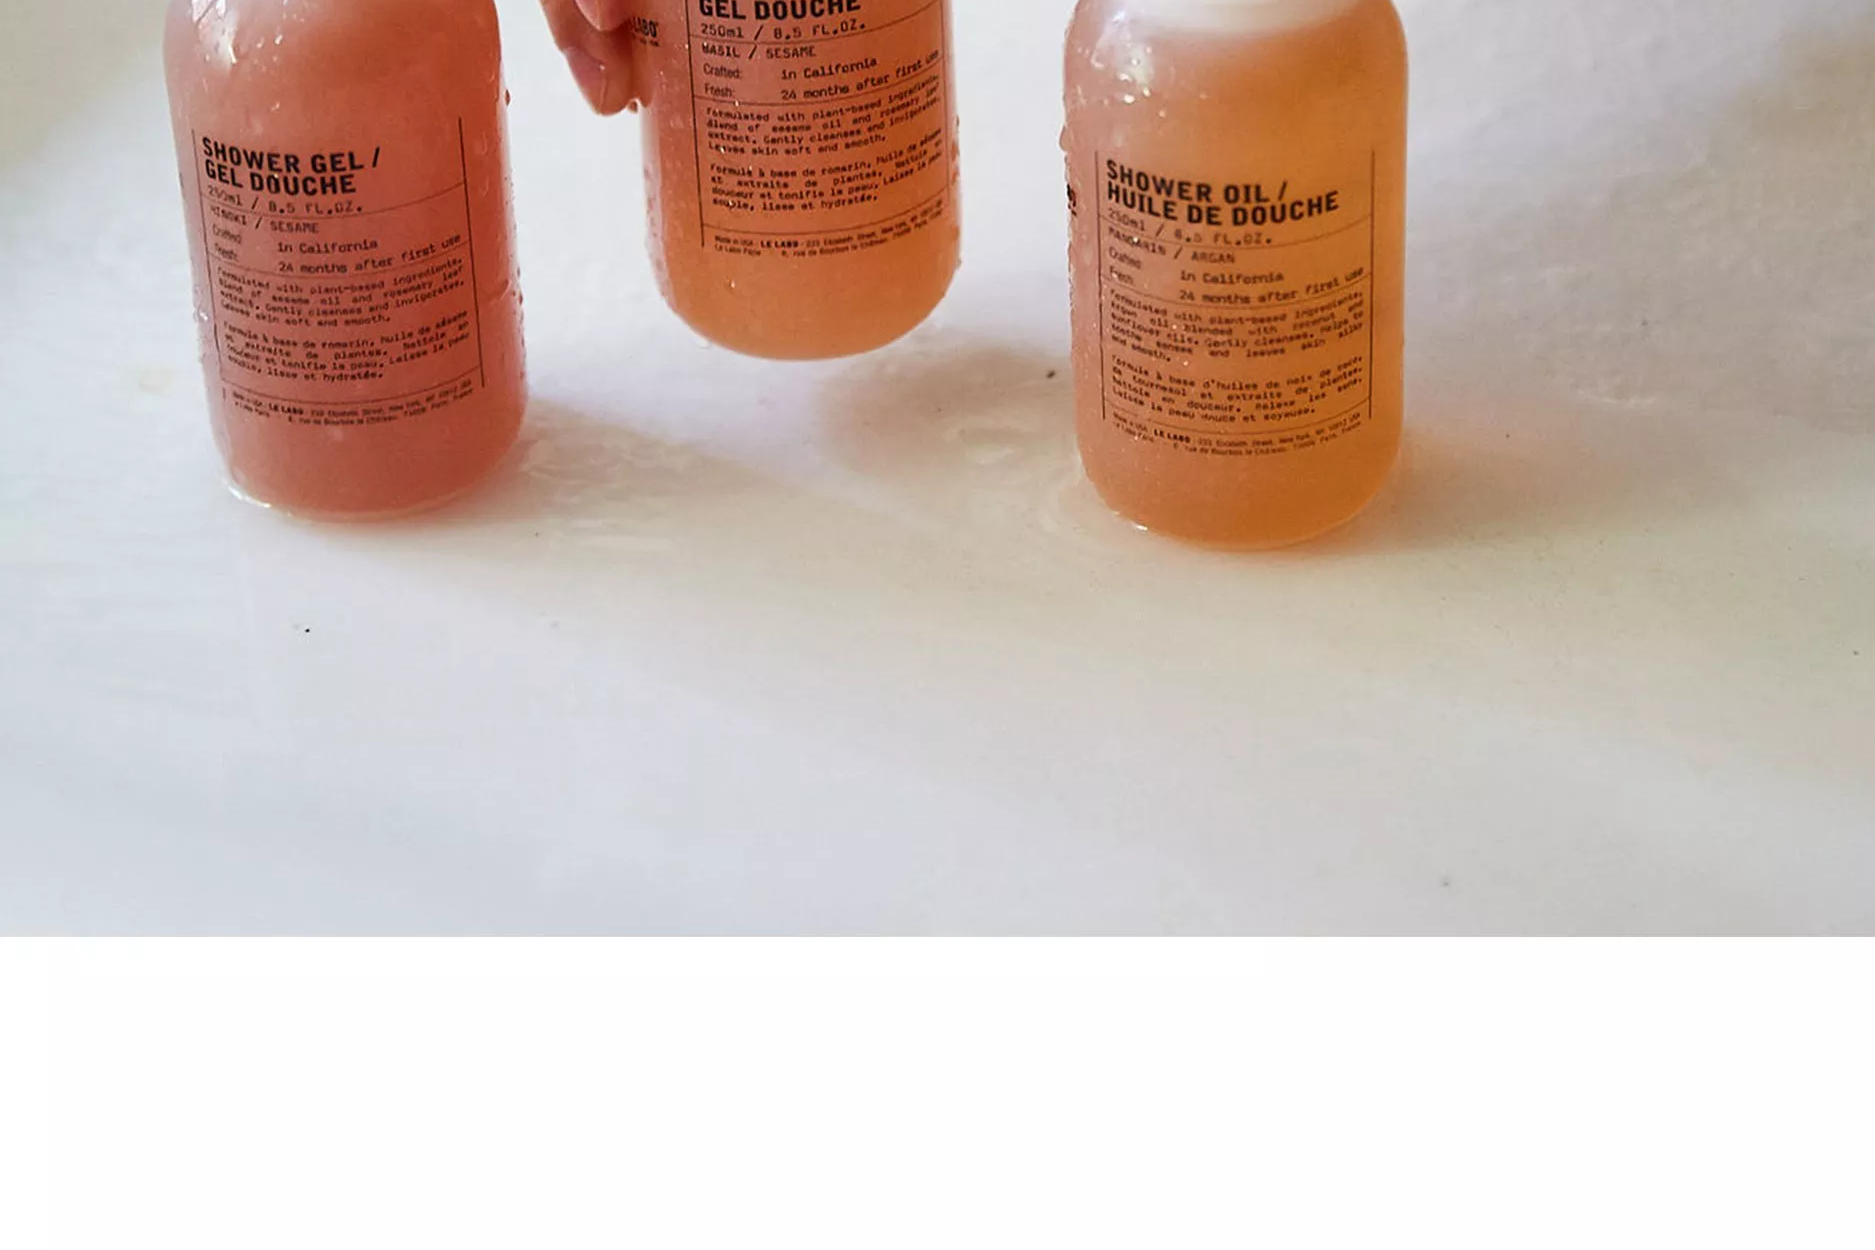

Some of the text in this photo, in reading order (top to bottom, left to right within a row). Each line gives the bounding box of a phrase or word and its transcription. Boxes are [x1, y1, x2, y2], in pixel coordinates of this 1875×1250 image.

[701, 22, 744, 39] 250ml
[754, 24, 763, 40] /
[812, 18, 866, 37] FL.OZ.
[748, 44, 758, 60] /
[766, 44, 817, 59] SESAME
[781, 57, 877, 80] in California
[781, 88, 797, 100] 24
[804, 84, 850, 99] months
[855, 74, 890, 91] after
[895, 58, 922, 78] first
[777, 109, 805, 123] with
[812, 99, 882, 120] plant-based
[852, 113, 871, 126] and
[763, 135, 804, 150] Gently
[867, 120, 885, 134] and
[202, 137, 380, 174] SHOWER GEL /
[818, 142, 838, 154] and
[205, 158, 356, 196] GEL DOUCHE
[802, 168, 816, 178] de
[1106, 158, 1288, 205] SHOWER OIL /
[805, 179, 818, 189] de
[251, 196, 259, 210] /
[778, 189, 825, 201] tonifie
[1107, 180, 1179, 221] HUILE
[1187, 203, 1223, 226] DE
[1232, 189, 1340, 227] DOUCHE
[255, 217, 262, 230] /
[270, 221, 319, 234] SESAME
[1155, 221, 1166, 238] /
[278, 239, 379, 254] in California
[1173, 244, 1184, 259] /
[1191, 251, 1236, 264] ARGAN
[300, 263, 348, 274] months
[355, 257, 392, 271] after
[401, 242, 436, 261] first
[1179, 268, 1285, 285] in California
[1201, 293, 1251, 304] months
[1258, 288, 1299, 304] after
[1305, 276, 1340, 295] first
